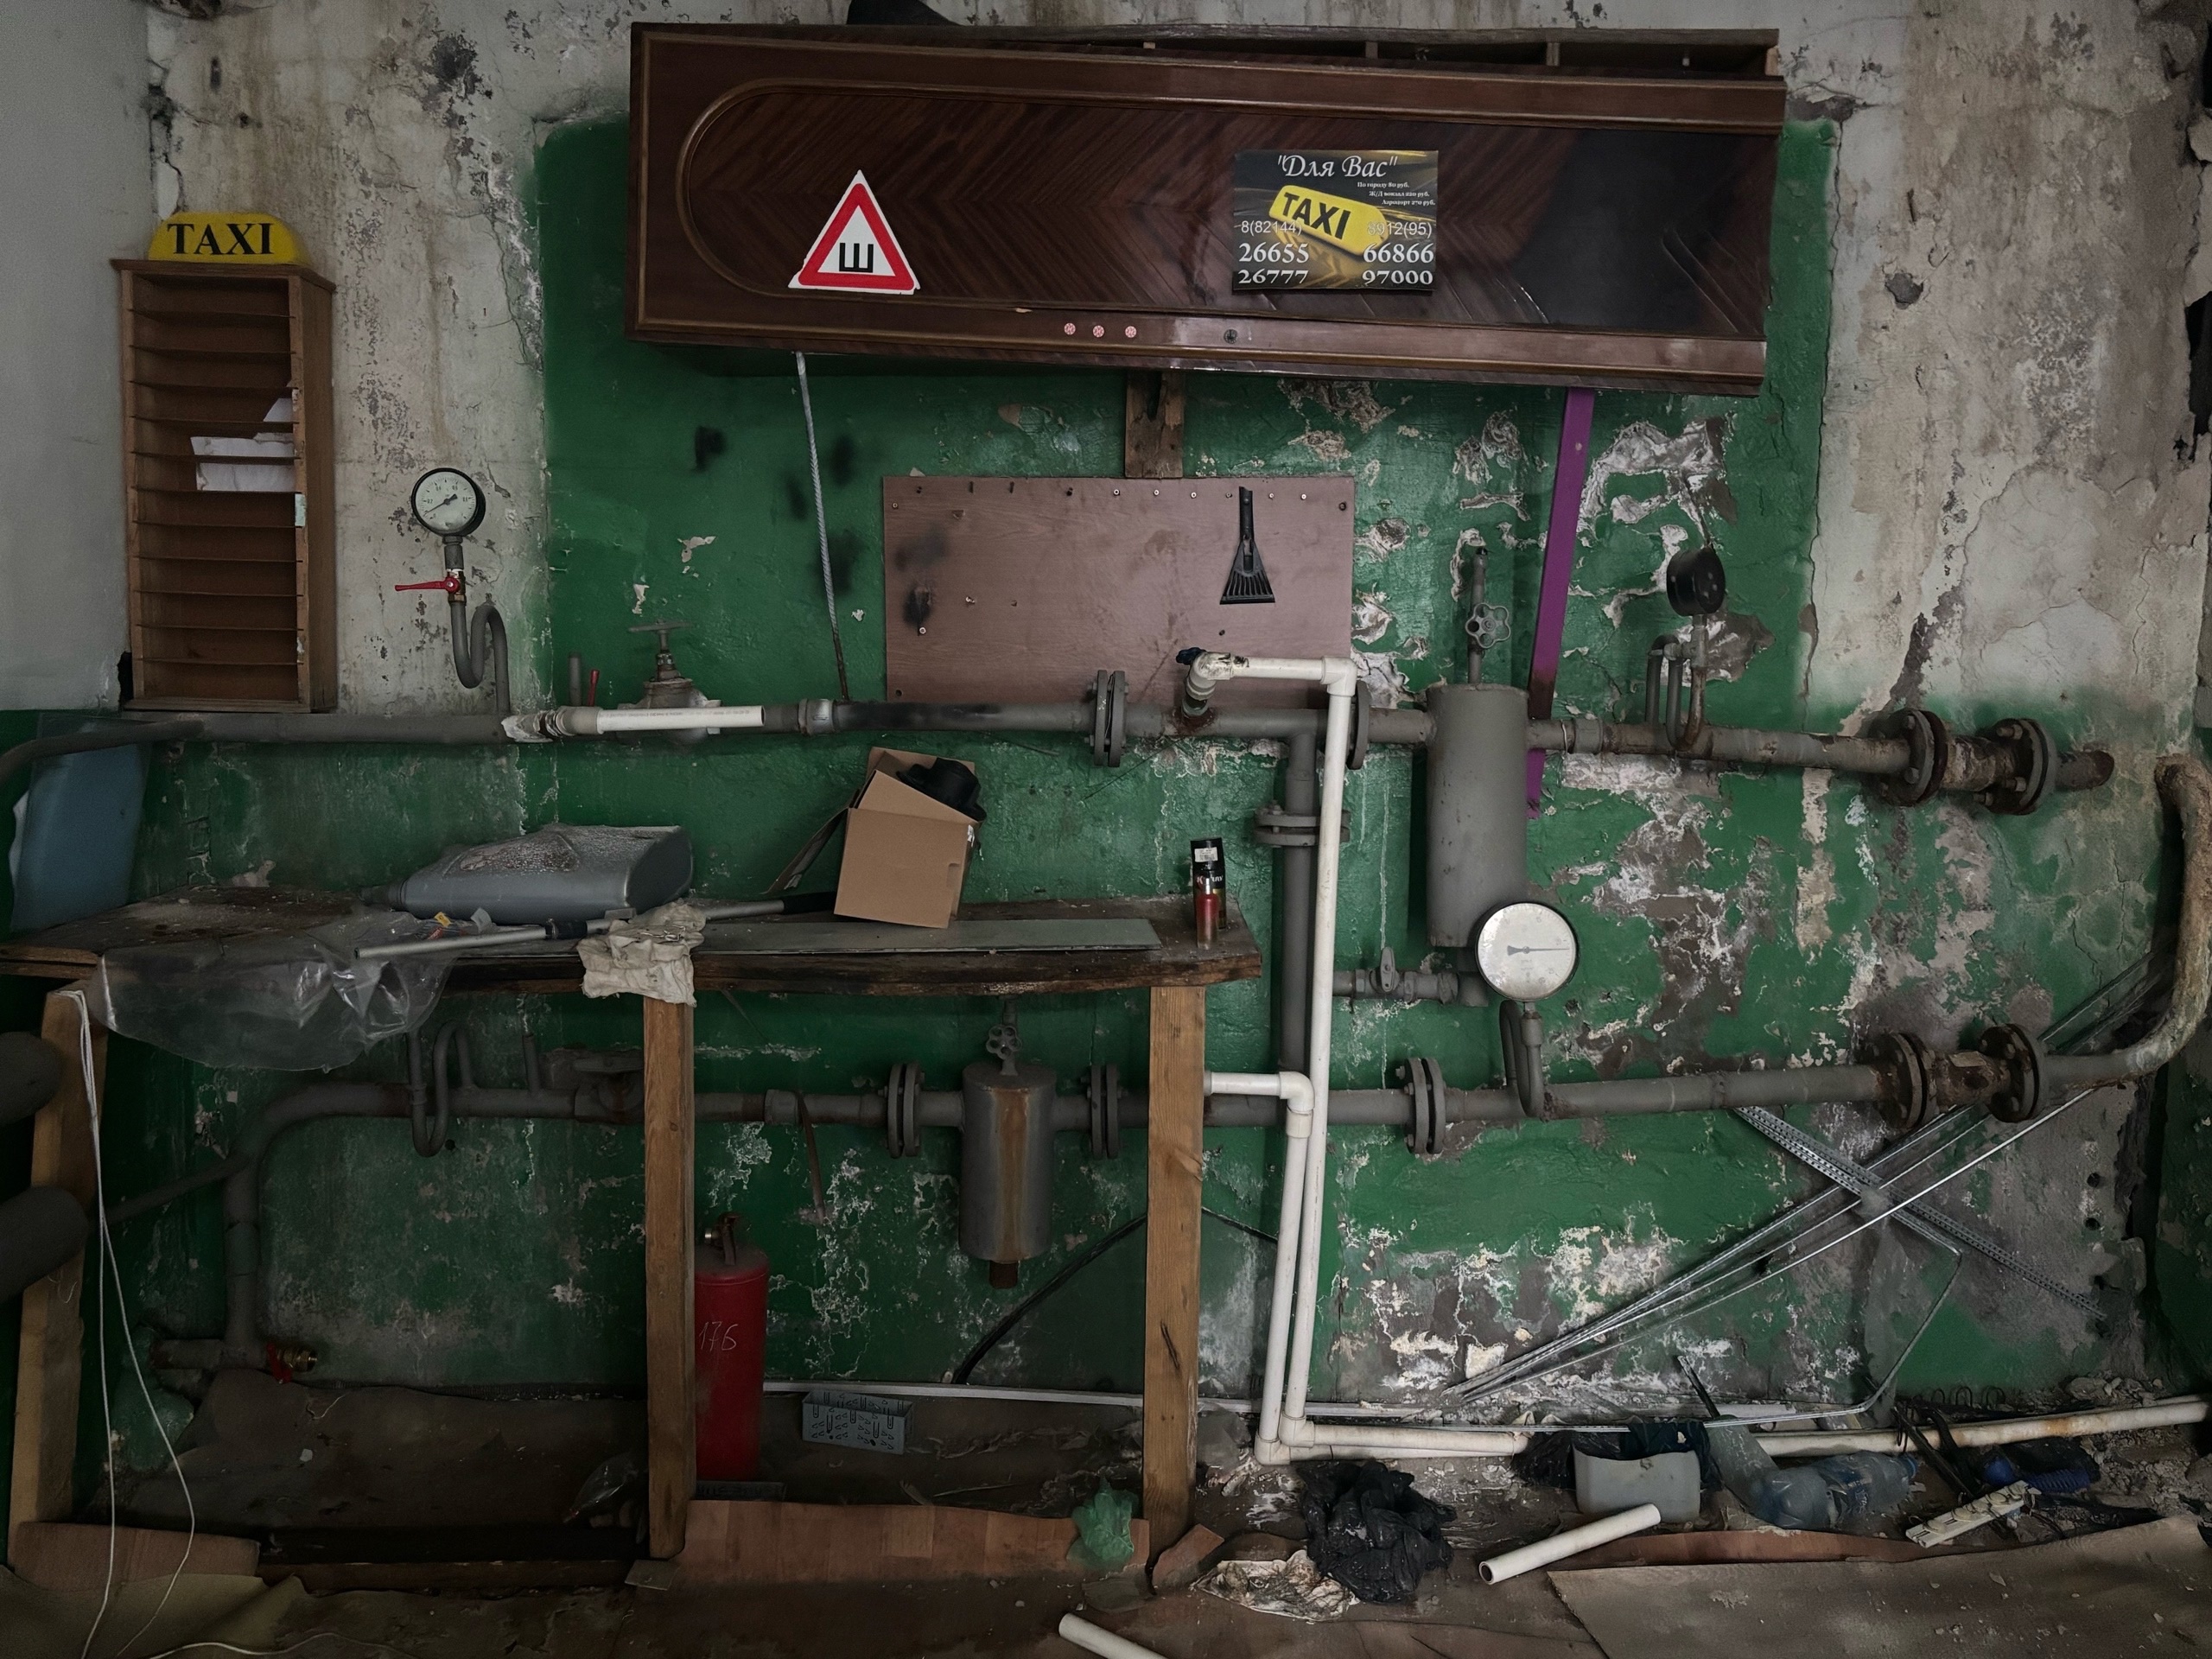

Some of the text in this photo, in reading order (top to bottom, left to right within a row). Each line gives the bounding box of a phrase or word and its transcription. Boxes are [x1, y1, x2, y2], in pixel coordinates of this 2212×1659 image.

[1277, 154, 1398, 177] "Для Вас"
[1281, 192, 1351, 239] TAXI
[1241, 220, 1302, 236] 8(82144)
[1367, 221, 1433, 238] 8912(95)
[167, 223, 275, 255] TAXI
[839, 243, 874, 273] Ш
[1238, 242, 1310, 263] 26655
[1363, 242, 1434, 263] 66866
[1238, 268, 1309, 284] 26777
[1362, 270, 1433, 285] 97000
